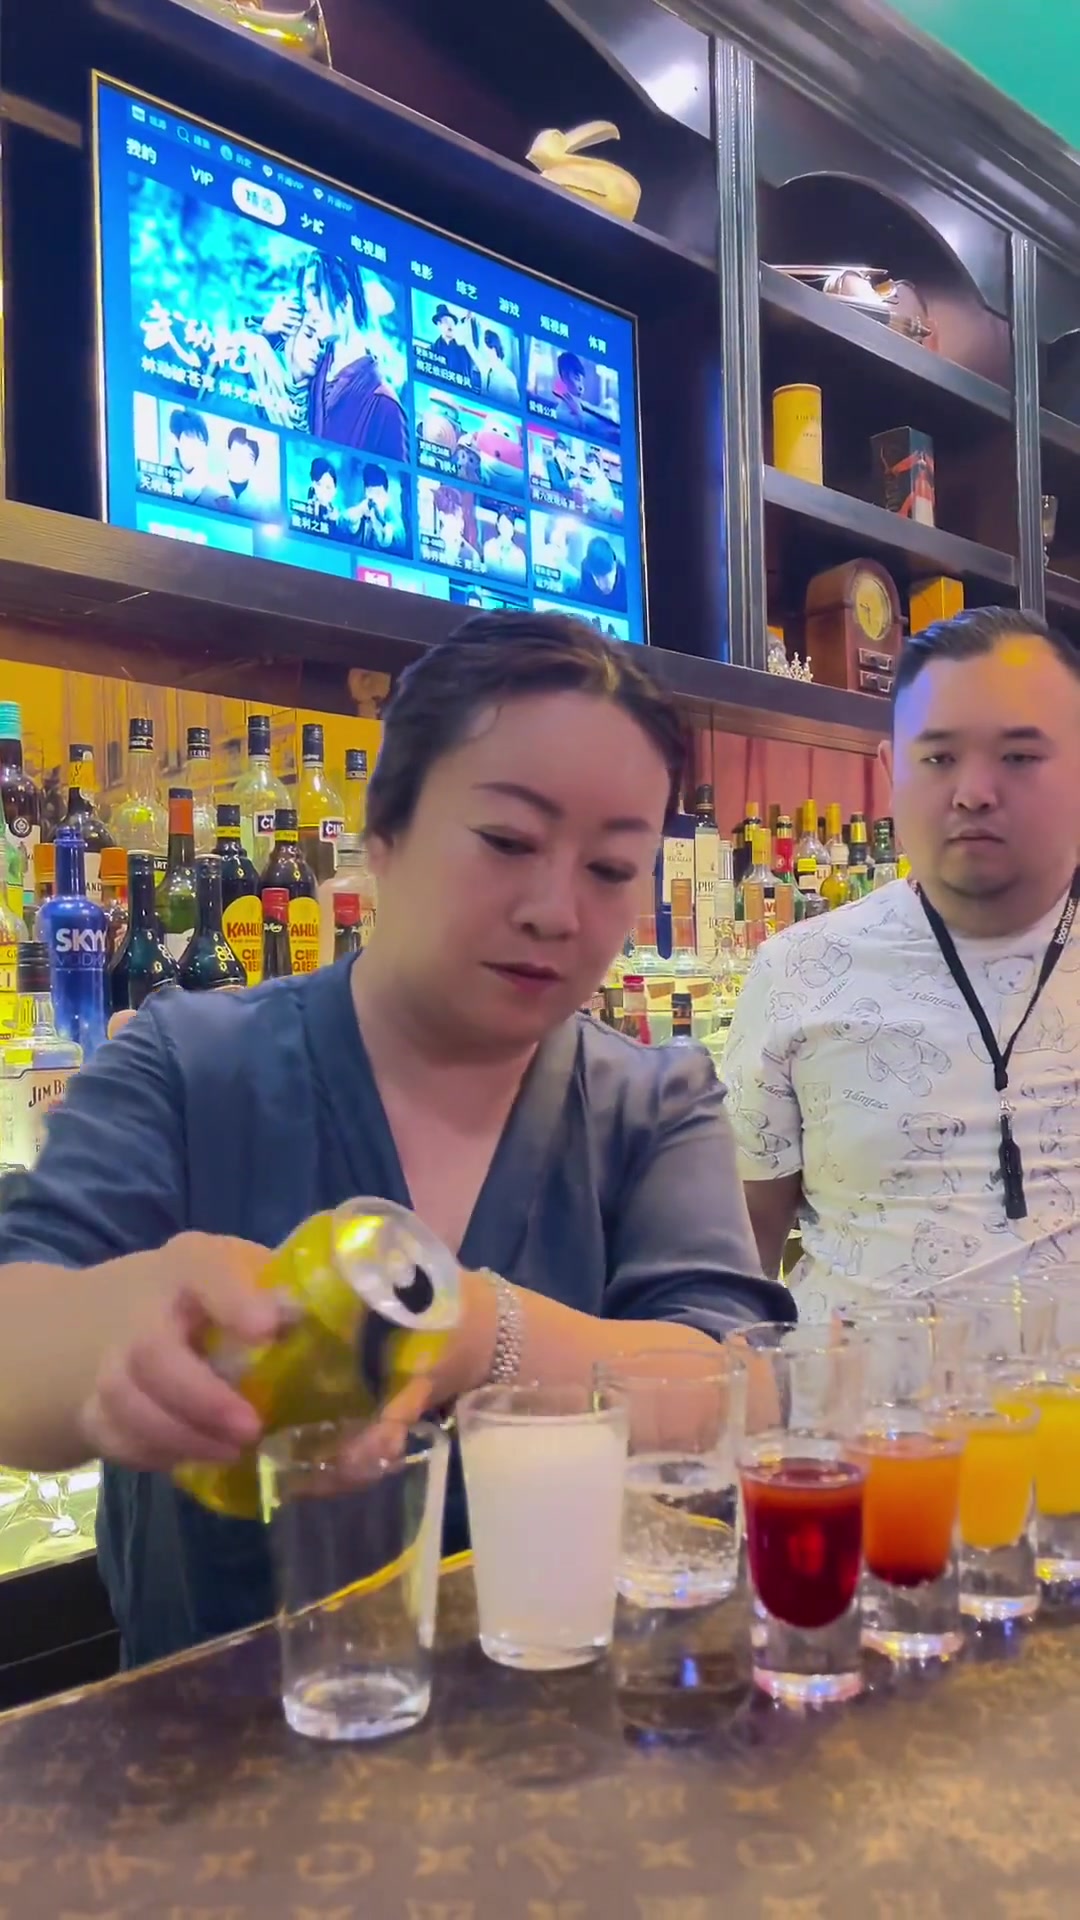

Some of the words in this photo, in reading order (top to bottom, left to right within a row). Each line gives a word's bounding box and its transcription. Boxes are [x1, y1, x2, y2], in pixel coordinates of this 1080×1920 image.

[126, 136, 158, 165] 我的
[190, 164, 215, 186] VIP
[351, 234, 387, 263] 电视剧
[411, 260, 434, 281] 电影
[456, 278, 478, 300] 综艺
[499, 296, 520, 318] 游戏
[540, 314, 570, 338] 短视频
[588, 334, 607, 354] 体育
[28, 1085, 51, 1108] JIM
